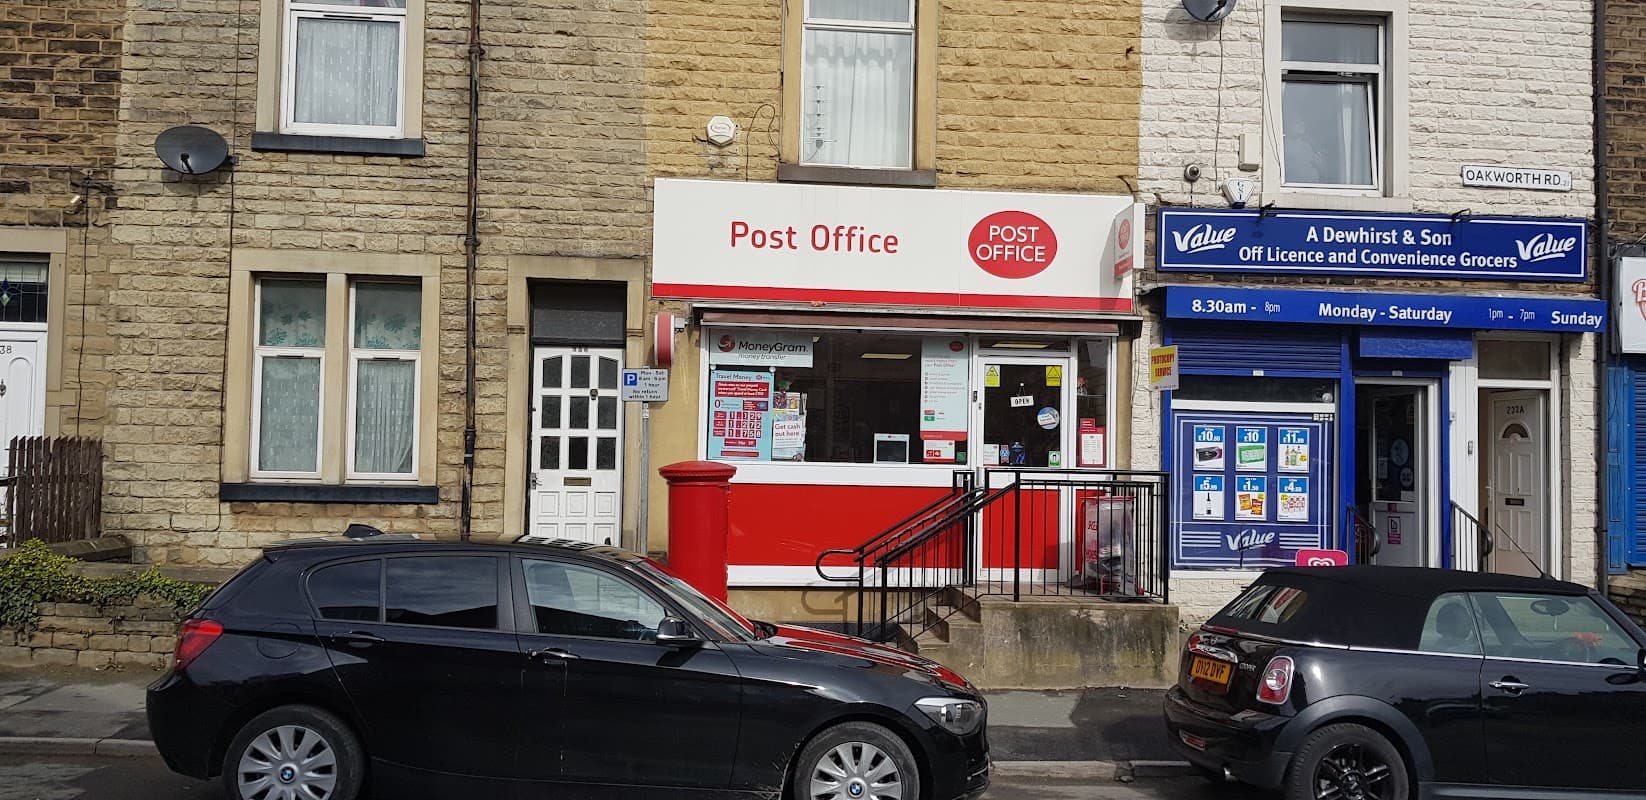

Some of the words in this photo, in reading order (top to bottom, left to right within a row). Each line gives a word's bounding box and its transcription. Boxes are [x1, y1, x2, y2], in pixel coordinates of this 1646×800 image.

[1466, 169, 1541, 184] OAKWORTH
[730, 221, 798, 249] Post
[811, 224, 899, 253] Office
[989, 225, 1039, 243] POST
[1172, 223, 1236, 254] Value
[1306, 226, 1318, 242] A
[1323, 227, 1398, 245] Dewhirst
[1402, 230, 1416, 245] &
[1420, 229, 1452, 246] Son
[976, 244, 1046, 263] OFFICE
[1239, 246, 1263, 261] Off
[1267, 247, 1324, 263] Licence
[1328, 248, 1357, 263] and
[1361, 249, 1456, 266] Convenience
[1460, 252, 1518, 268] Grocers
[1515, 233, 1577, 262] Value
[1191, 299, 1247, 313] 8.30am
[1264, 301, 1281, 315] 8pm
[1319, 303, 1377, 322] Monday
[1388, 305, 1453, 324] Saturday
[1488, 308, 1504, 321] 1pm
[1519, 308, 1536, 321] 7pm
[1551, 310, 1603, 328] Sunday
[1152, 353, 1175, 364] PHOTOCOPY
[626, 374, 636, 385] P
[1155, 367, 1172, 377] SERVICE
[1244, 432, 1259, 442] £10
[1225, 529, 1275, 551] Value
